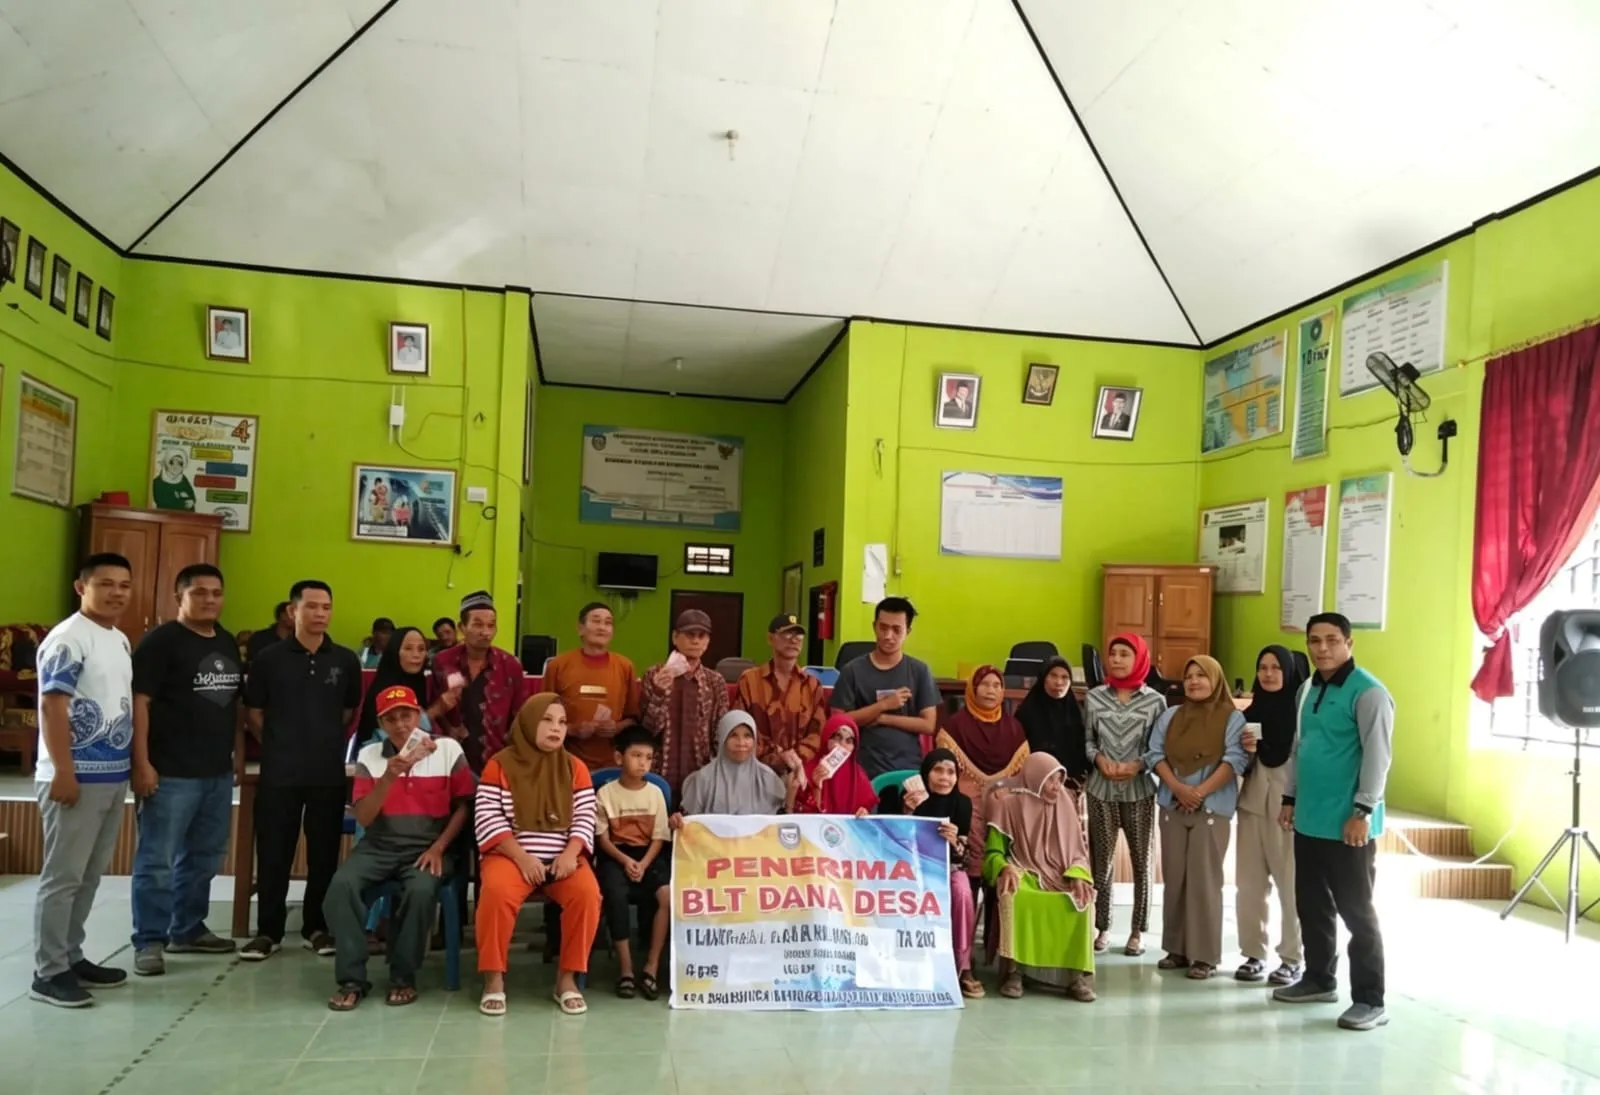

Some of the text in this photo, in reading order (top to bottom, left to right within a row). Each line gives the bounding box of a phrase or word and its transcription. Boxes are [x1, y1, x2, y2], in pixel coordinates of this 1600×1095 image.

[706, 856, 917, 881] PENERIMA
[681, 883, 942, 917] BLT DANA DESA
